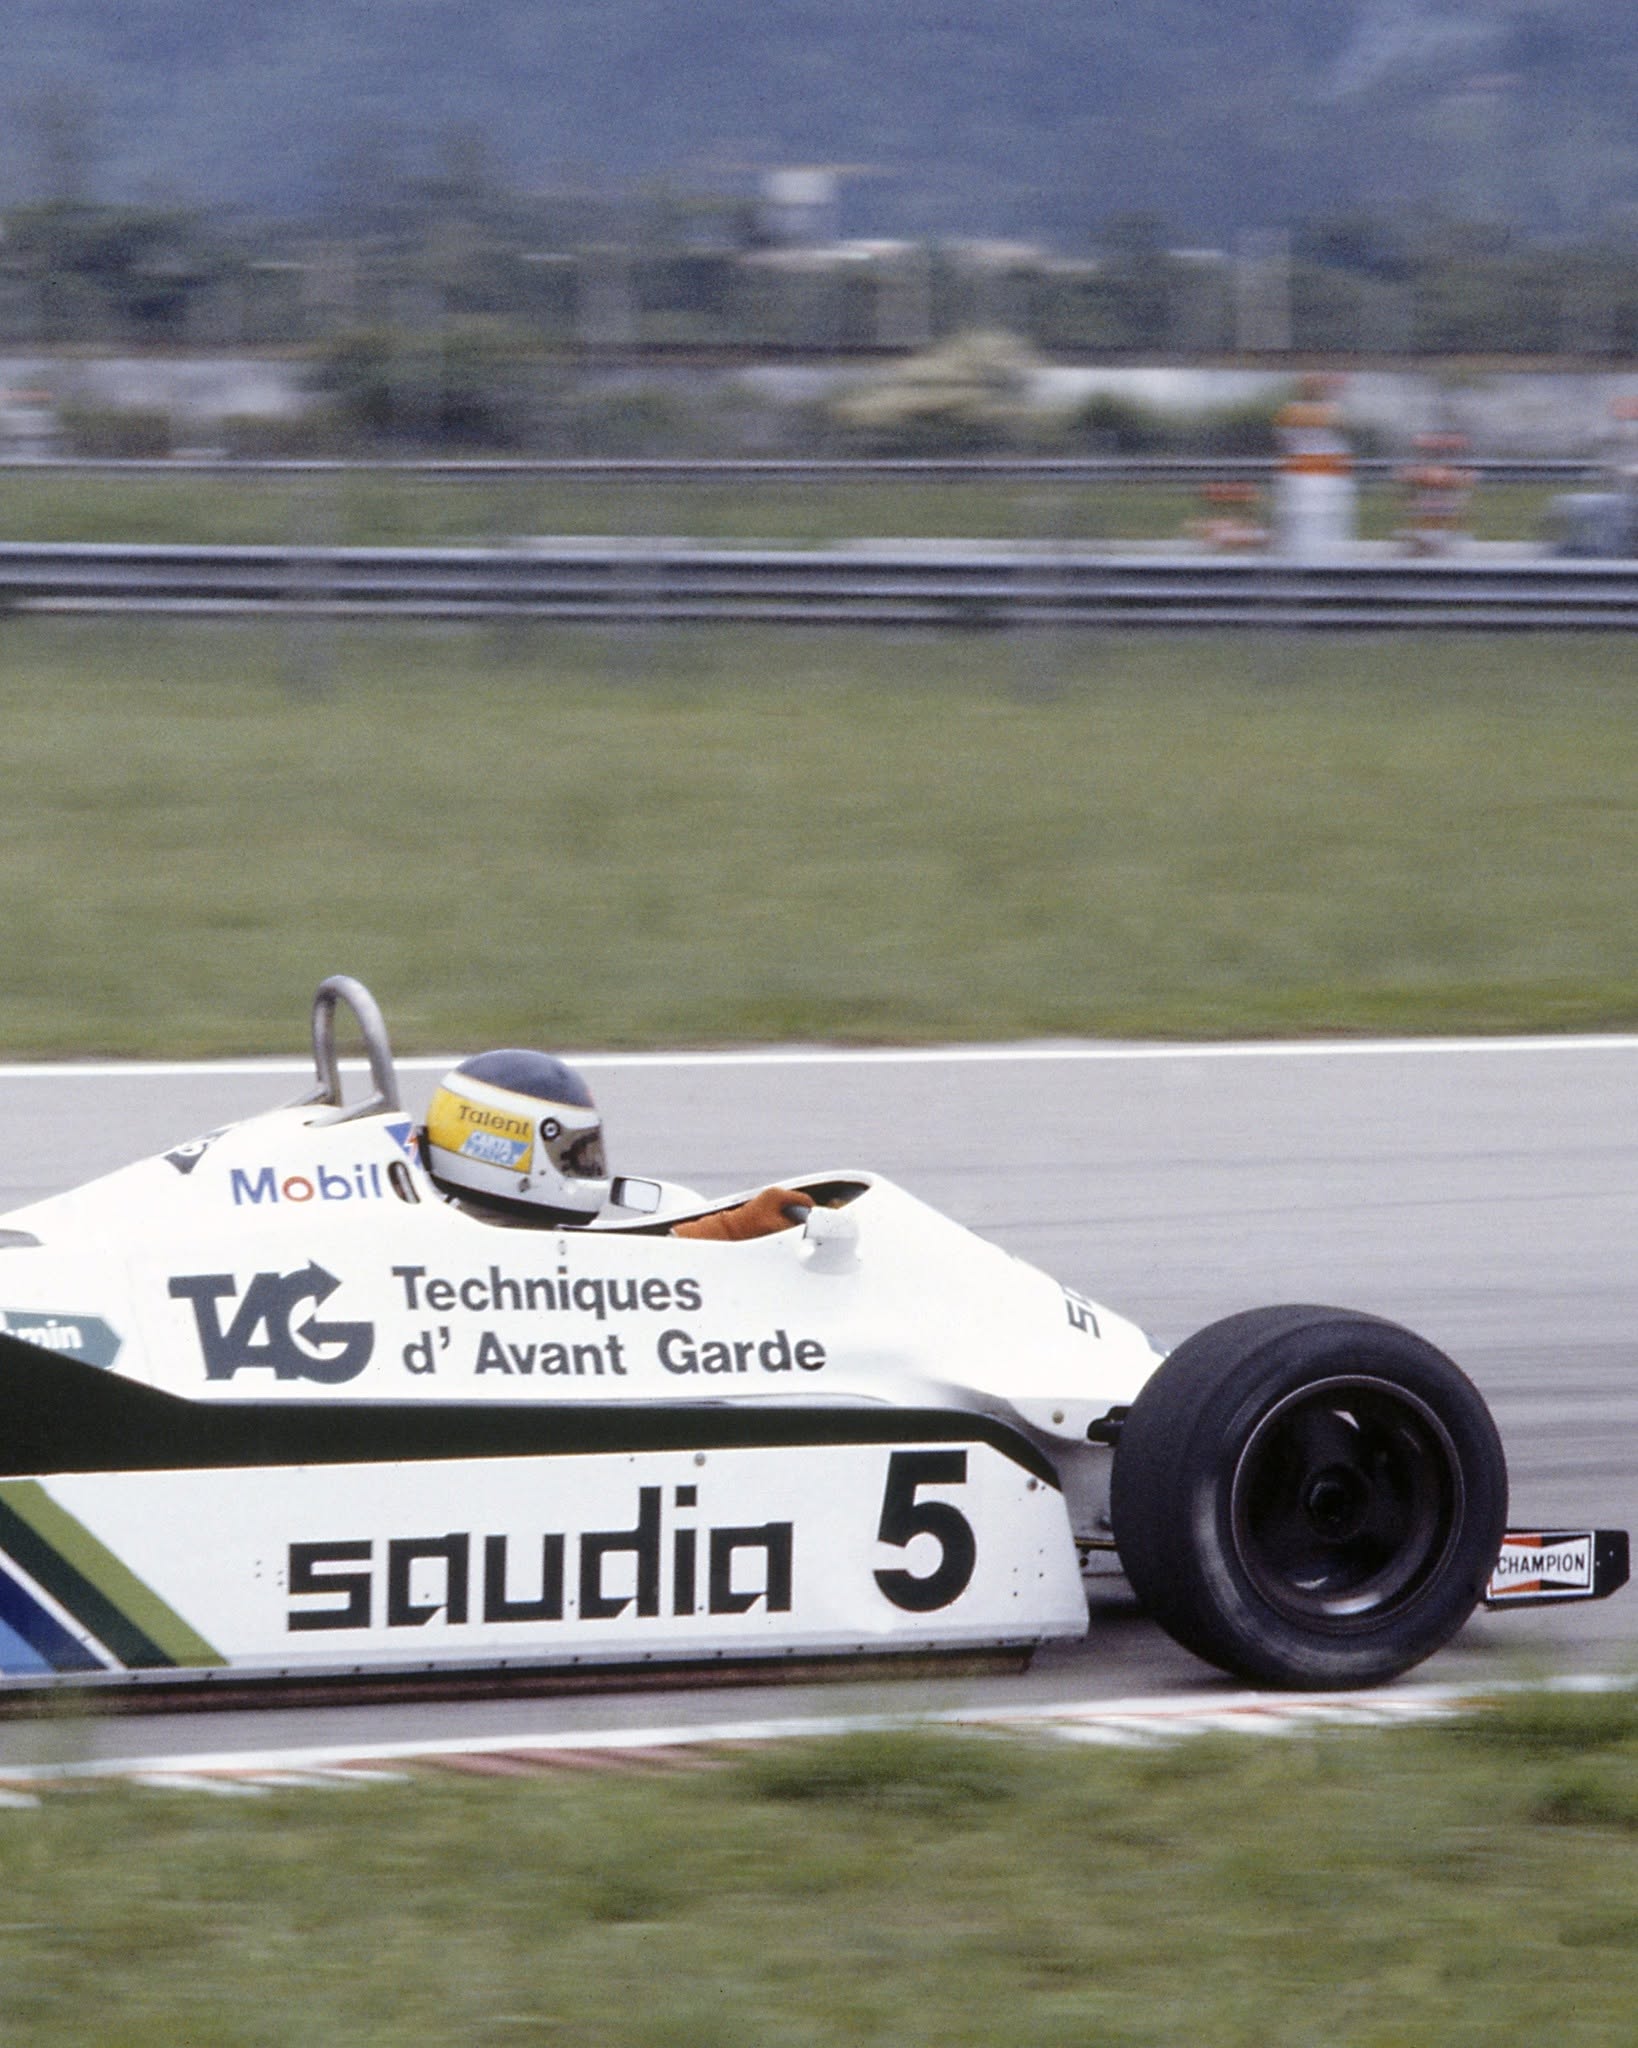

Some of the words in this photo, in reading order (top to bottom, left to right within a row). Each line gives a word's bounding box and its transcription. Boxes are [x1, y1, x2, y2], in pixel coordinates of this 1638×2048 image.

[459, 1105, 529, 1135] Talent
[231, 1164, 381, 1205] Mobil
[391, 1265, 702, 1321] Techniques
[168, 1260, 375, 1384] TAG
[474, 1331, 627, 1376] Avant
[657, 1329, 827, 1375] Garde
[873, 1450, 976, 1613] 5
[288, 1485, 793, 1631] saudia
[1497, 1553, 1585, 1574] CHAMPION
